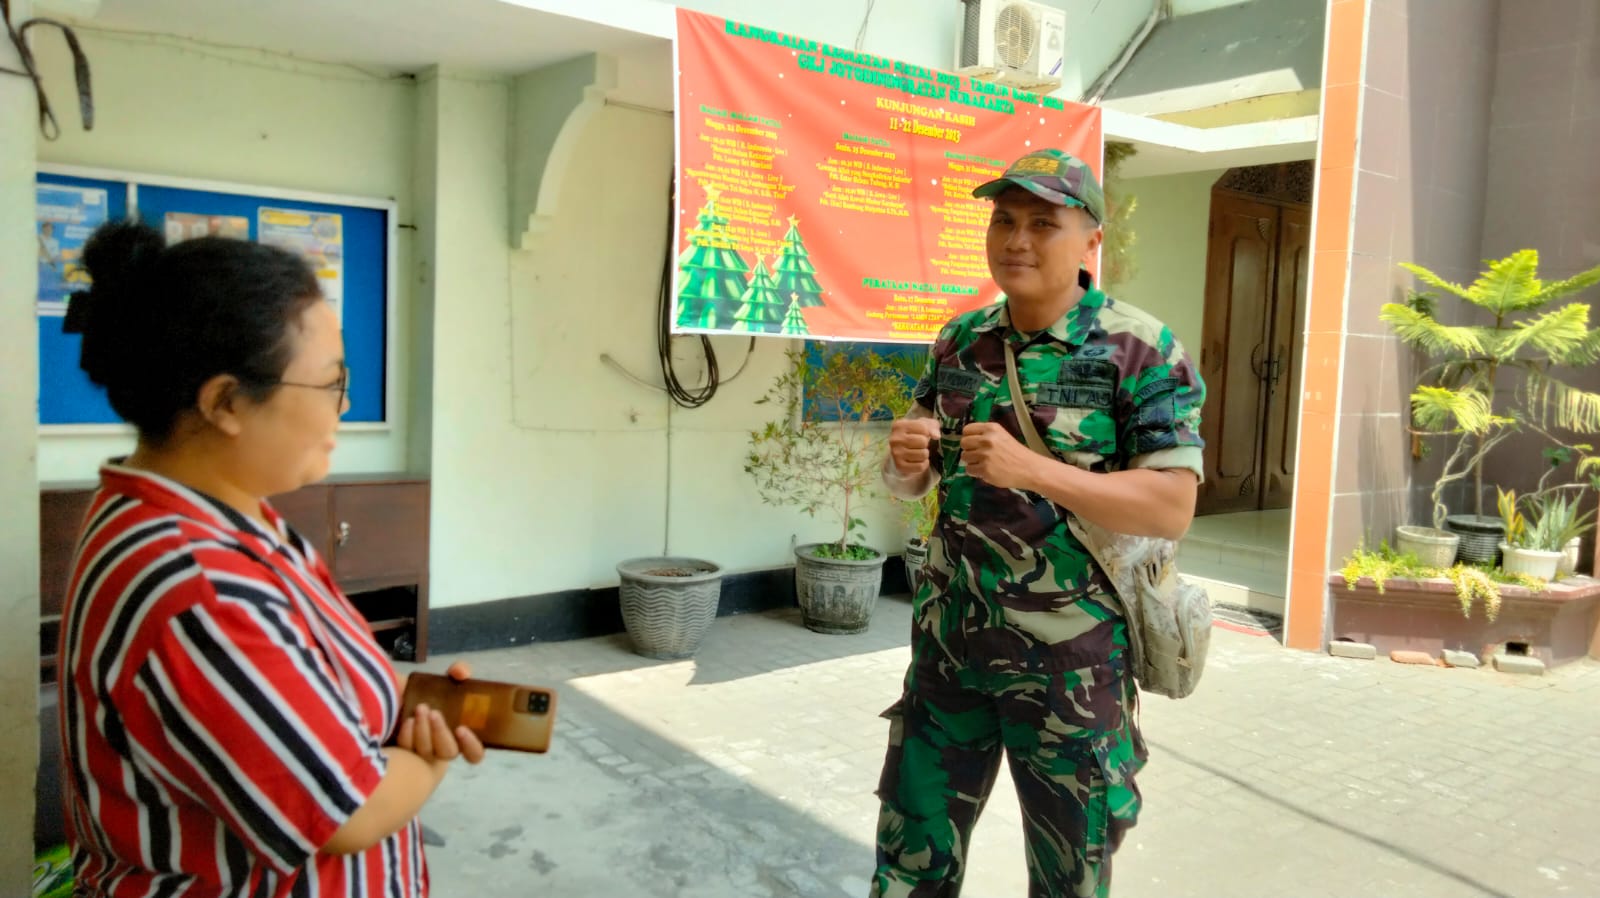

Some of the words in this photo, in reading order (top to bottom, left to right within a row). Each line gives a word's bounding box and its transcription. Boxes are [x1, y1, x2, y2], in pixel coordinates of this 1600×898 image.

[798, 53, 825, 73] GKJ
[949, 89, 1015, 115] SURAKARTA
[876, 97, 944, 119] KUNJUNGAN
[945, 111, 976, 127] KASIH
[889, 117, 897, 130] 11
[912, 119, 945, 139] Desember
[1047, 388, 1078, 402] TNI
